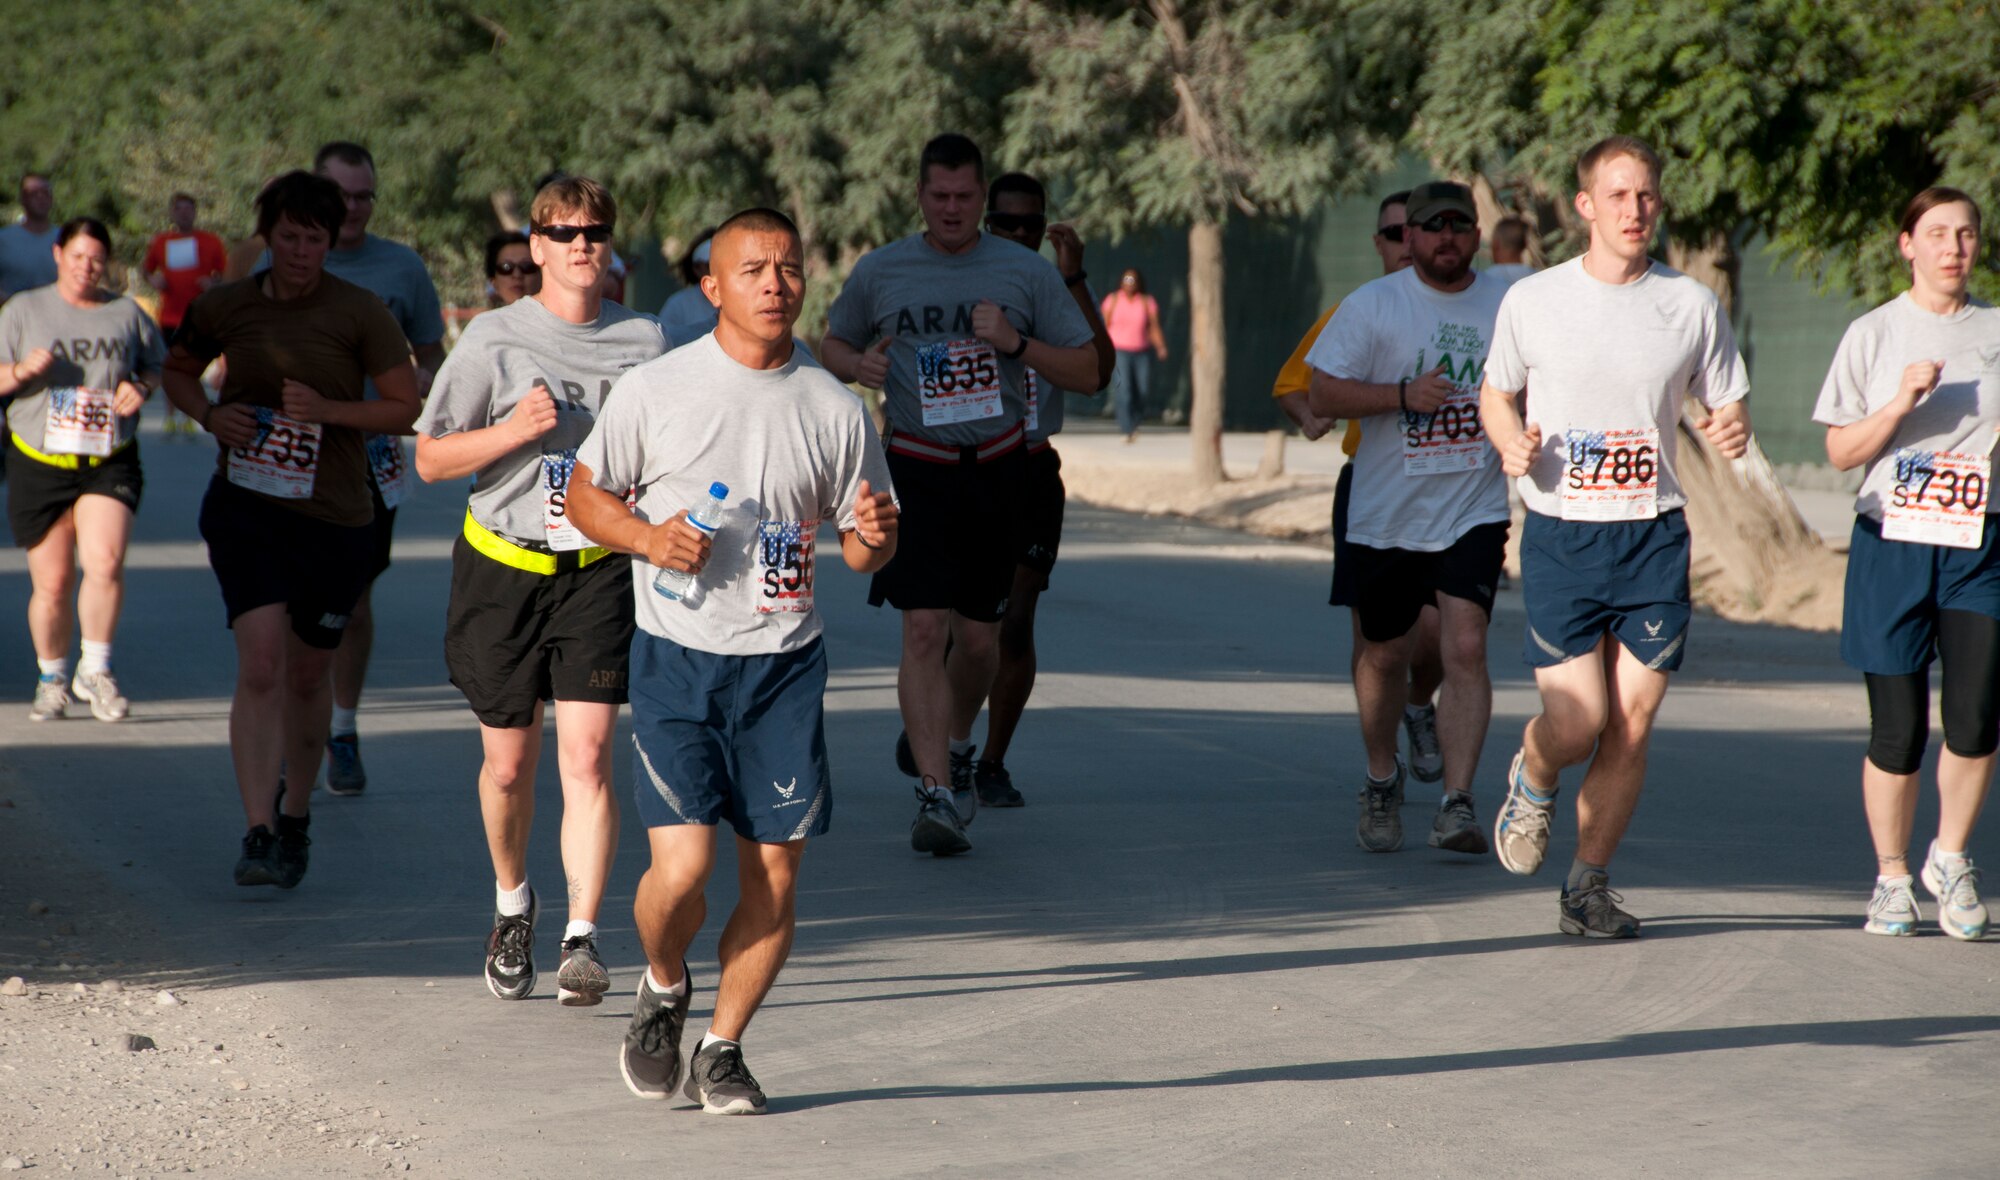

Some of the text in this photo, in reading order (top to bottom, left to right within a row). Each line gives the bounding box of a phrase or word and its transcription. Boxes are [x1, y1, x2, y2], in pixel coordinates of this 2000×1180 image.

[896, 303, 1008, 335] ARM
[936, 352, 995, 392] 635
[256, 423, 316, 467] 735
[1588, 445, 1653, 485] 786
[1914, 466, 1984, 511] 730
[588, 670, 627, 689] AR
